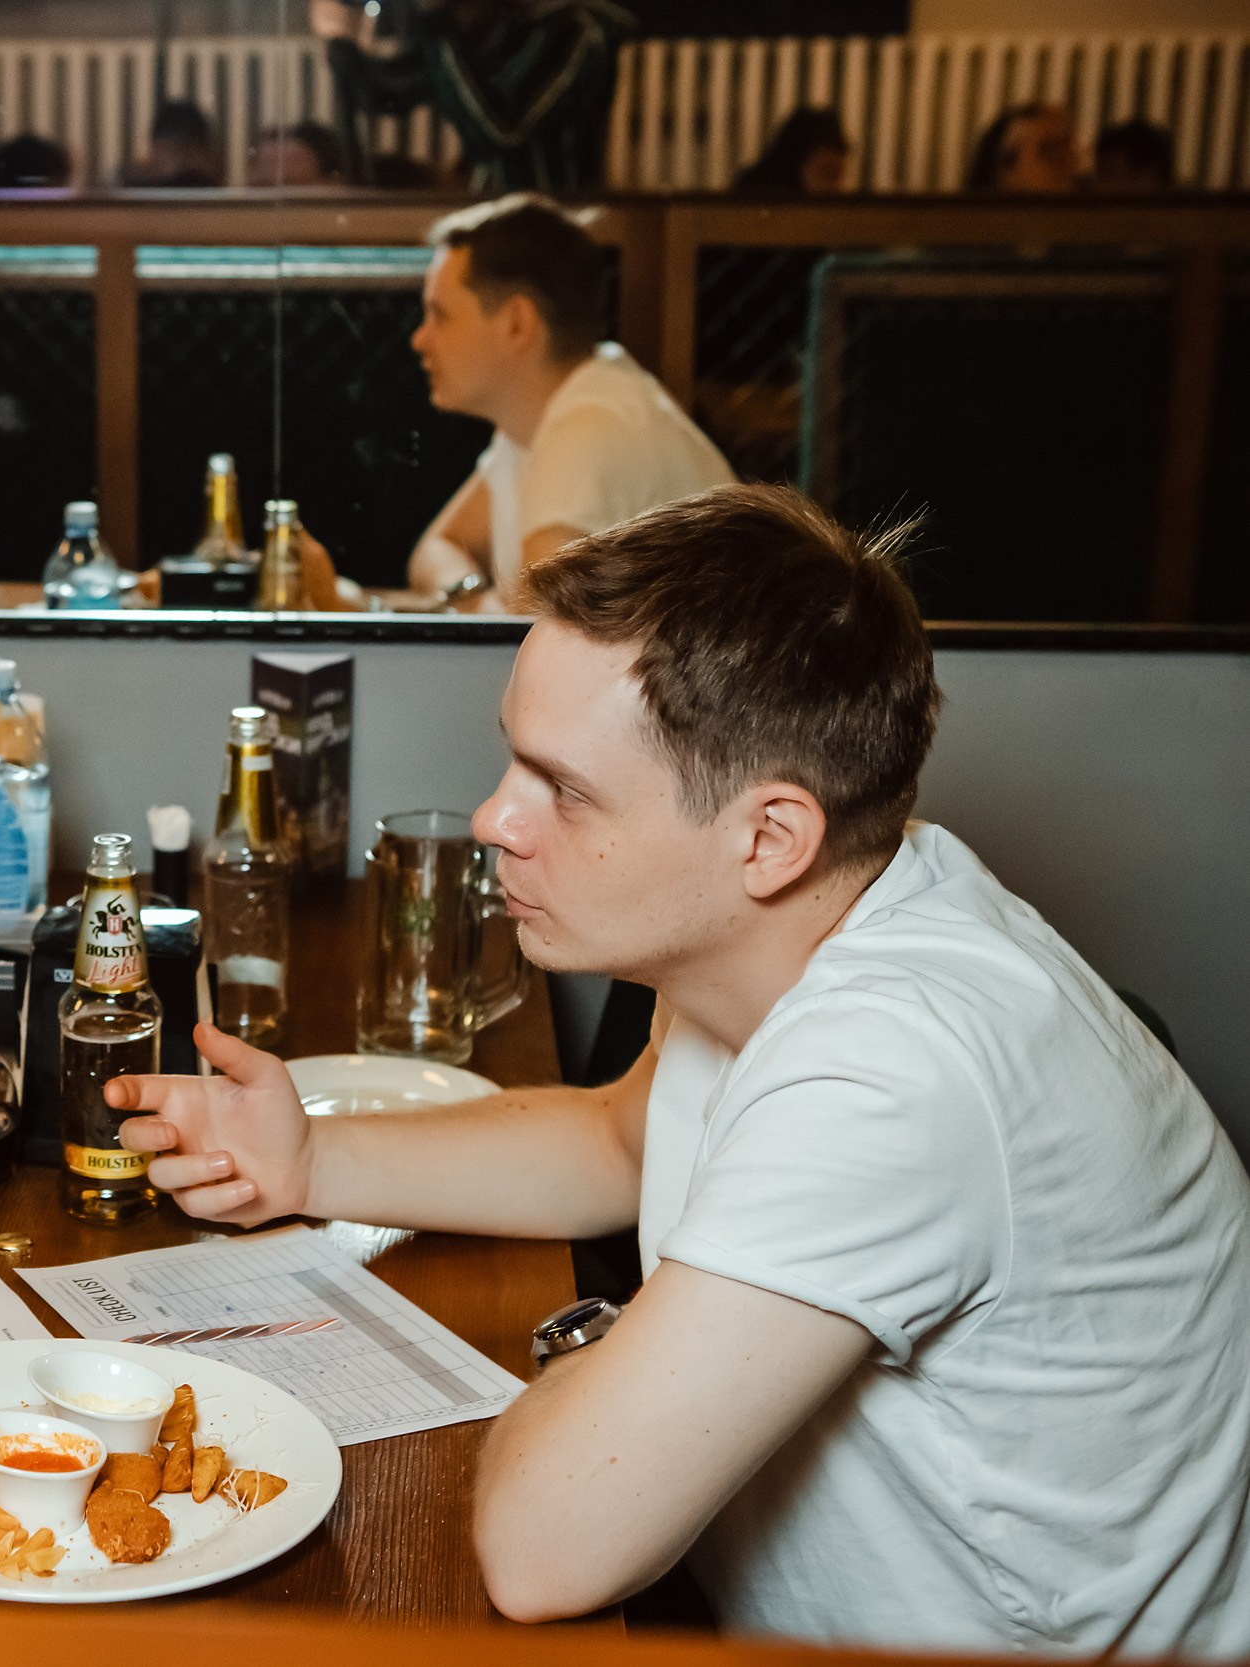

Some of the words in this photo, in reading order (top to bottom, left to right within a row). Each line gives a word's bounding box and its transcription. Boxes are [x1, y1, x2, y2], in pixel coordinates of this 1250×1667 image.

[85, 942, 142, 958] HOLSTEN
[86, 956, 139, 984] Light
[87, 1155, 145, 1169] HOLSTEN
[72, 1277, 106, 1295] LIST
[91, 1293, 137, 1322] CHECK
